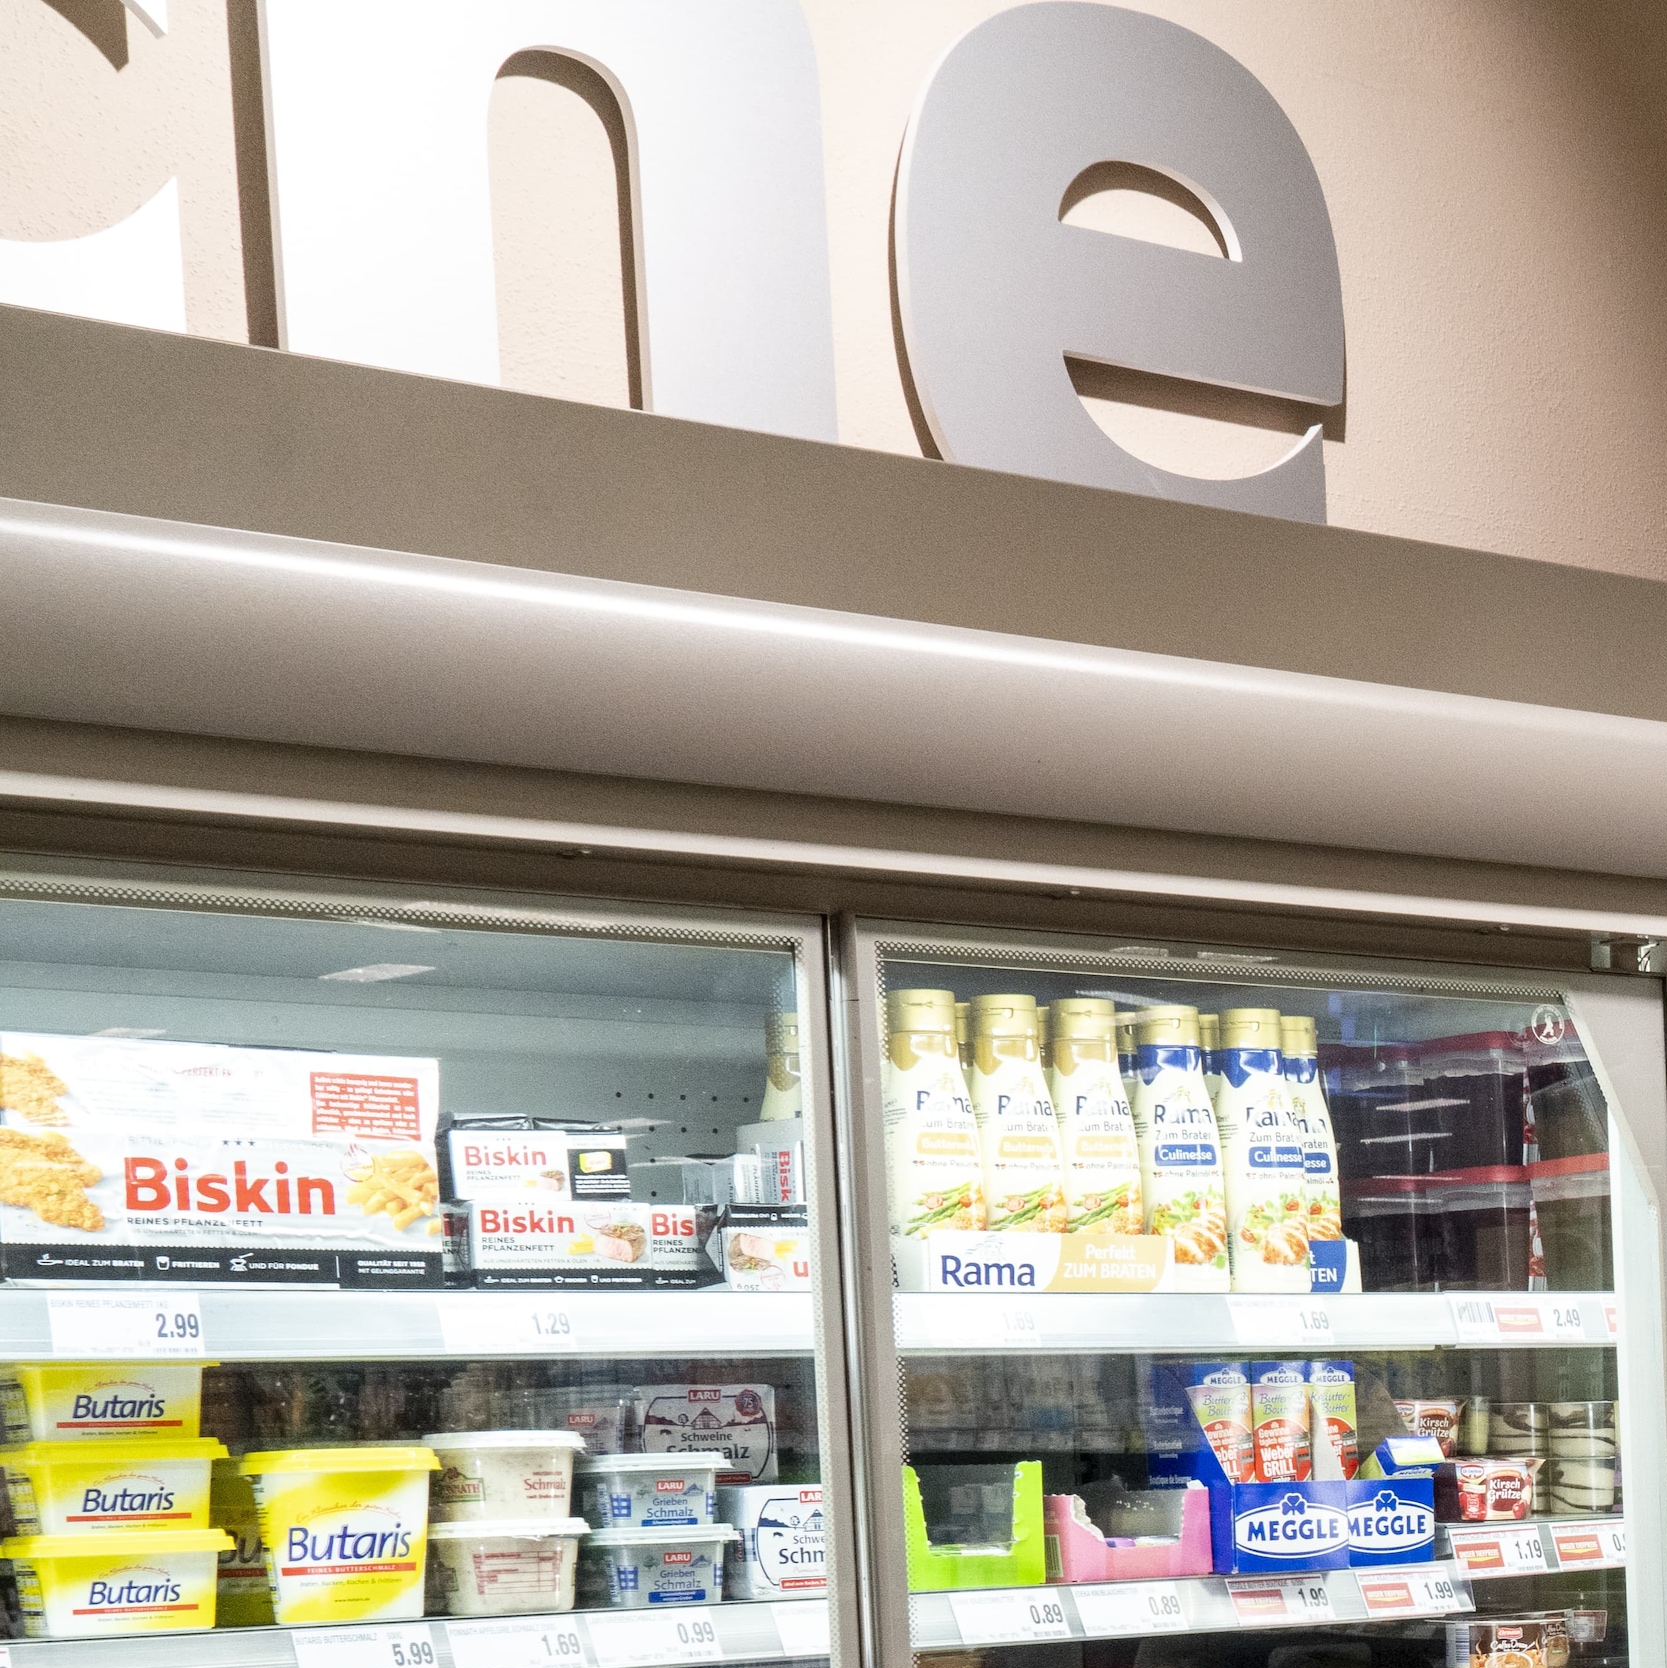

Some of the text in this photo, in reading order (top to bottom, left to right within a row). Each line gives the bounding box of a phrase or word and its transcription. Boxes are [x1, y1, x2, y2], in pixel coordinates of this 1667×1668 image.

[464, 1146, 546, 1166] Biskin
[1159, 1149, 1212, 1161] Culinesse
[125, 1157, 335, 1215] Biskin
[128, 1217, 169, 1227] REINES
[480, 1209, 574, 1233] Biskin
[1085, 1245, 1136, 1260] Perfekt
[65, 1259, 144, 1268] IDEAL ZUM BRATEN
[172, 1261, 219, 1269] FRITTIEREN
[249, 1261, 319, 1271] UND FÜR FONDUE
[942, 1256, 1035, 1287] Rama
[1064, 1263, 1156, 1280] ZUM BRATEN
[156, 1314, 199, 1338] 2.99
[1210, 1374, 1241, 1384] MEGGLE
[1266, 1374, 1298, 1384] MEGGLE
[1316, 1373, 1346, 1383] MEGGLE
[690, 1391, 719, 1400] LARU
[73, 1394, 165, 1419] Butaris
[1419, 1417, 1449, 1428] Kirsch
[681, 1432, 732, 1442] Schweine
[1418, 1426, 1450, 1439] Grütze
[1261, 1448, 1288, 1462] Weber
[1263, 1459, 1296, 1477] GRILL
[524, 1478, 566, 1491] Schmalz
[658, 1482, 683, 1490] LARU
[1489, 1478, 1521, 1491] Kirsch
[83, 1487, 174, 1512] Butaris
[1487, 1488, 1523, 1501] Grütze
[652, 1498, 688, 1507] Grieben
[647, 1507, 693, 1519] Schmalz
[1248, 1518, 1339, 1542] MEGGLE
[288, 1522, 411, 1562] Butaris
[1515, 1540, 1543, 1559] 1.19
[665, 1553, 691, 1562] LARU
[660, 1569, 695, 1578] Grieben
[654, 1578, 701, 1590] Schmalz
[89, 1579, 180, 1605] Butaris
